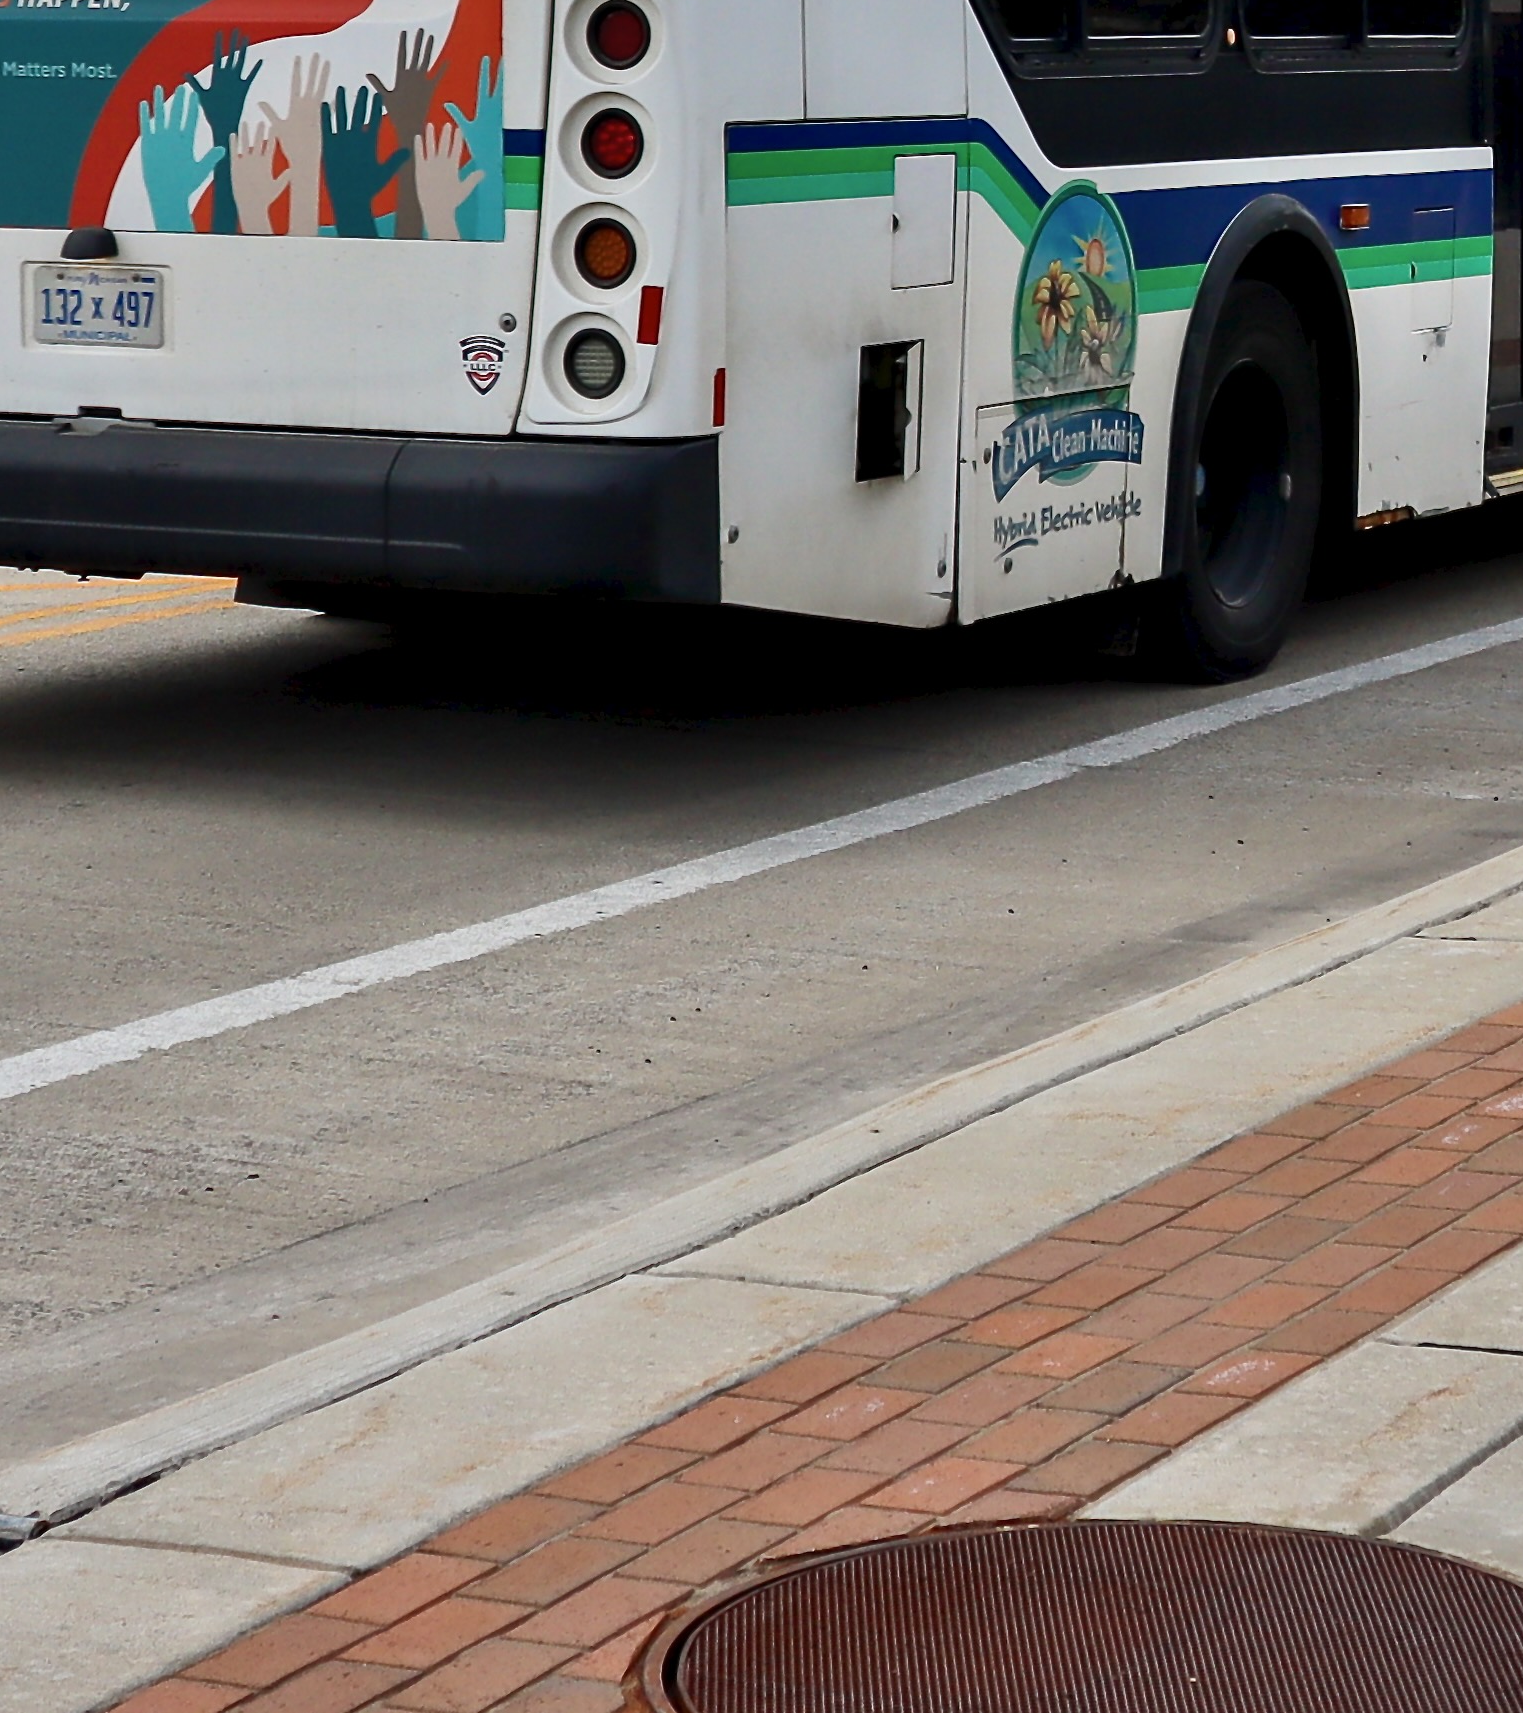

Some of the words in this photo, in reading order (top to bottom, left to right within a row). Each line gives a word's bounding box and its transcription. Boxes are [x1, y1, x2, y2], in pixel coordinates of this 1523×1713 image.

[2, 61, 66, 78] Matters
[70, 62, 118, 79] Most.
[41, 288, 83, 326] 132
[112, 290, 155, 328] 497
[998, 413, 1050, 486] CATA
[1051, 427, 1086, 463] Clean
[993, 511, 1037, 550] Hybrid
[1040, 503, 1094, 537] Electric
[1095, 490, 1143, 524] Vehicle
